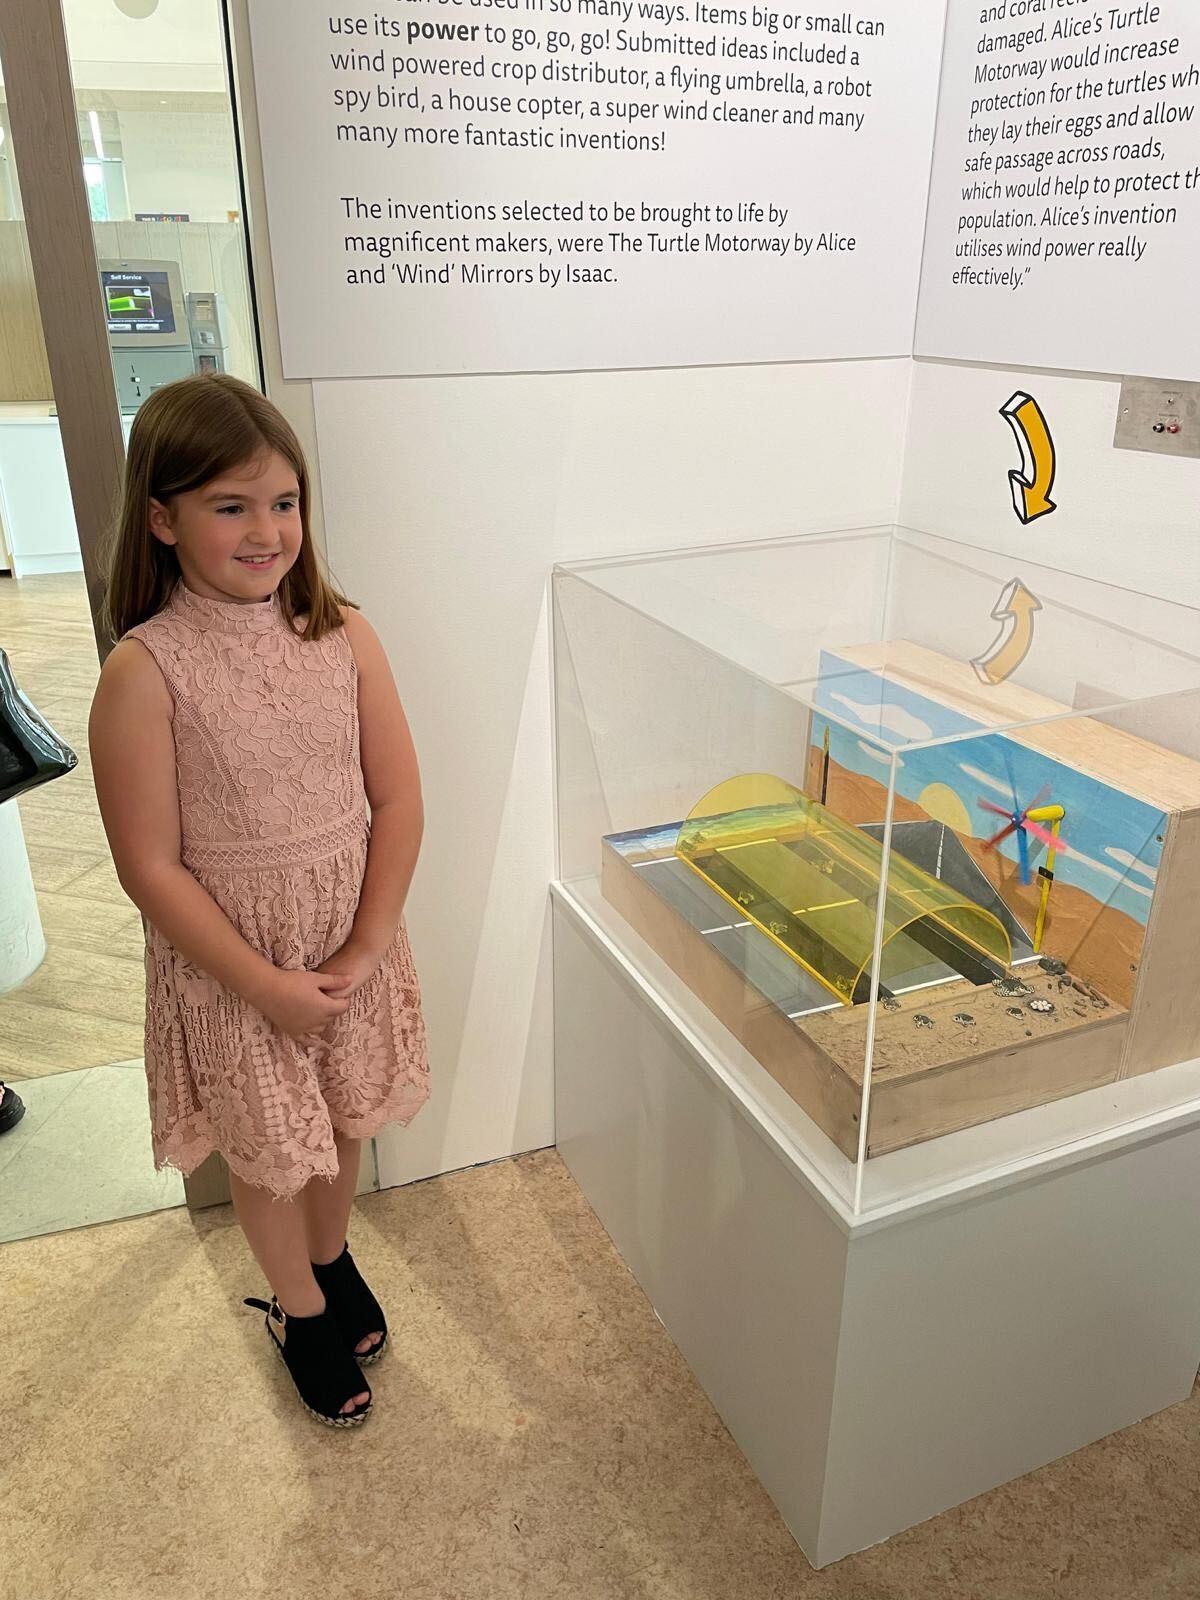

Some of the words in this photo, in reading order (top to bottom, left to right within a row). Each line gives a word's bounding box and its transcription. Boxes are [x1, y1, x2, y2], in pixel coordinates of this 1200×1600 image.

[549, 0, 572, 13] so
[578, 0, 634, 23] many
[637, 3, 689, 26] ways.
[695, 1, 747, 26] Items
[752, 5, 779, 35] big
[782, 14, 802, 30] or
[805, 12, 852, 34] small
[856, 20, 885, 36] can
[977, 22, 1047, 54] damaged.
[1108, 1, 1160, 30] Turtle
[979, 0, 1007, 24] and
[328, 17, 368, 36] use
[374, 13, 401, 38] its
[406, 21, 480, 45] power
[484, 23, 506, 44] to
[511, 28, 541, 52] go,
[546, 30, 575, 54] go,
[580, 28, 610, 56] go!
[616, 29, 716, 57] Submitted
[722, 36, 768, 60] ideas
[773, 40, 847, 65] included
[850, 51, 860, 66] a
[330, 47, 385, 73] wind
[392, 54, 485, 80] powered
[491, 62, 537, 86] crop
[542, 58, 650, 90] distributor,
[655, 71, 666, 87] a
[670, 65, 721, 96] flying
[725, 70, 809, 97] umbrella,
[813, 80, 823, 95] a
[827, 75, 872, 98] robot
[974, 59, 1048, 84] Motorway
[1050, 43, 1101, 72] would
[1104, 38, 1179, 64] increase
[333, 89, 371, 113] spy
[377, 84, 425, 113] bird,
[431, 93, 444, 110] a
[449, 87, 512, 113] house
[517, 96, 584, 121] copter,
[589, 101, 601, 117] a
[605, 101, 660, 124] super
[663, 99, 708, 121] wind
[712, 101, 779, 124] cleaner
[782, 105, 814, 125] and
[818, 111, 865, 133] many
[970, 87, 1046, 120] protection
[1049, 82, 1073, 103] for
[1076, 78, 1103, 100] the
[1107, 70, 1167, 97] turtles
[336, 124, 398, 149] many
[404, 127, 460, 145] more
[464, 122, 554, 148] fantastic
[560, 127, 665, 151] inventions!
[968, 123, 999, 146] they
[1001, 119, 1023, 144] lay
[1025, 114, 1063, 137] their
[1065, 114, 1103, 138] eggs
[1106, 104, 1140, 129] and
[1142, 101, 1195, 126] allow
[964, 151, 992, 173] safe
[994, 151, 1054, 175] passage
[1056, 146, 1109, 165] across
[1112, 136, 1165, 161] roads,
[961, 180, 1002, 201] which
[1005, 176, 1052, 199] would
[1054, 174, 1090, 201] help
[1093, 176, 1111, 194] to
[1113, 171, 1181, 199] protect
[339, 196, 382, 219] The
[387, 197, 497, 221] inventions
[502, 199, 584, 222] selected
[588, 203, 608, 222] to
[614, 201, 636, 222] be
[641, 201, 711, 228] brought
[715, 205, 733, 223] to
[738, 202, 764, 223] life
[768, 203, 789, 228] by
[957, 208, 1037, 234] population.
[1093, 202, 1177, 225] invention
[344, 230, 471, 259] magnificent
[475, 231, 553, 256] makers,
[557, 237, 604, 253] were
[607, 232, 643, 253] The
[647, 232, 700, 253] Turtle
[705, 233, 791, 257] Motorway
[794, 232, 814, 257] by
[816, 232, 856, 251] Alice
[955, 238, 1003, 257] utilises
[1006, 236, 1042, 257] wind
[1044, 242, 1095, 262] power
[1098, 235, 1147, 262] really
[346, 263, 386, 285] and
[461, 263, 534, 284] Mirrors
[539, 263, 561, 289] by
[566, 263, 618, 283] Isaac.
